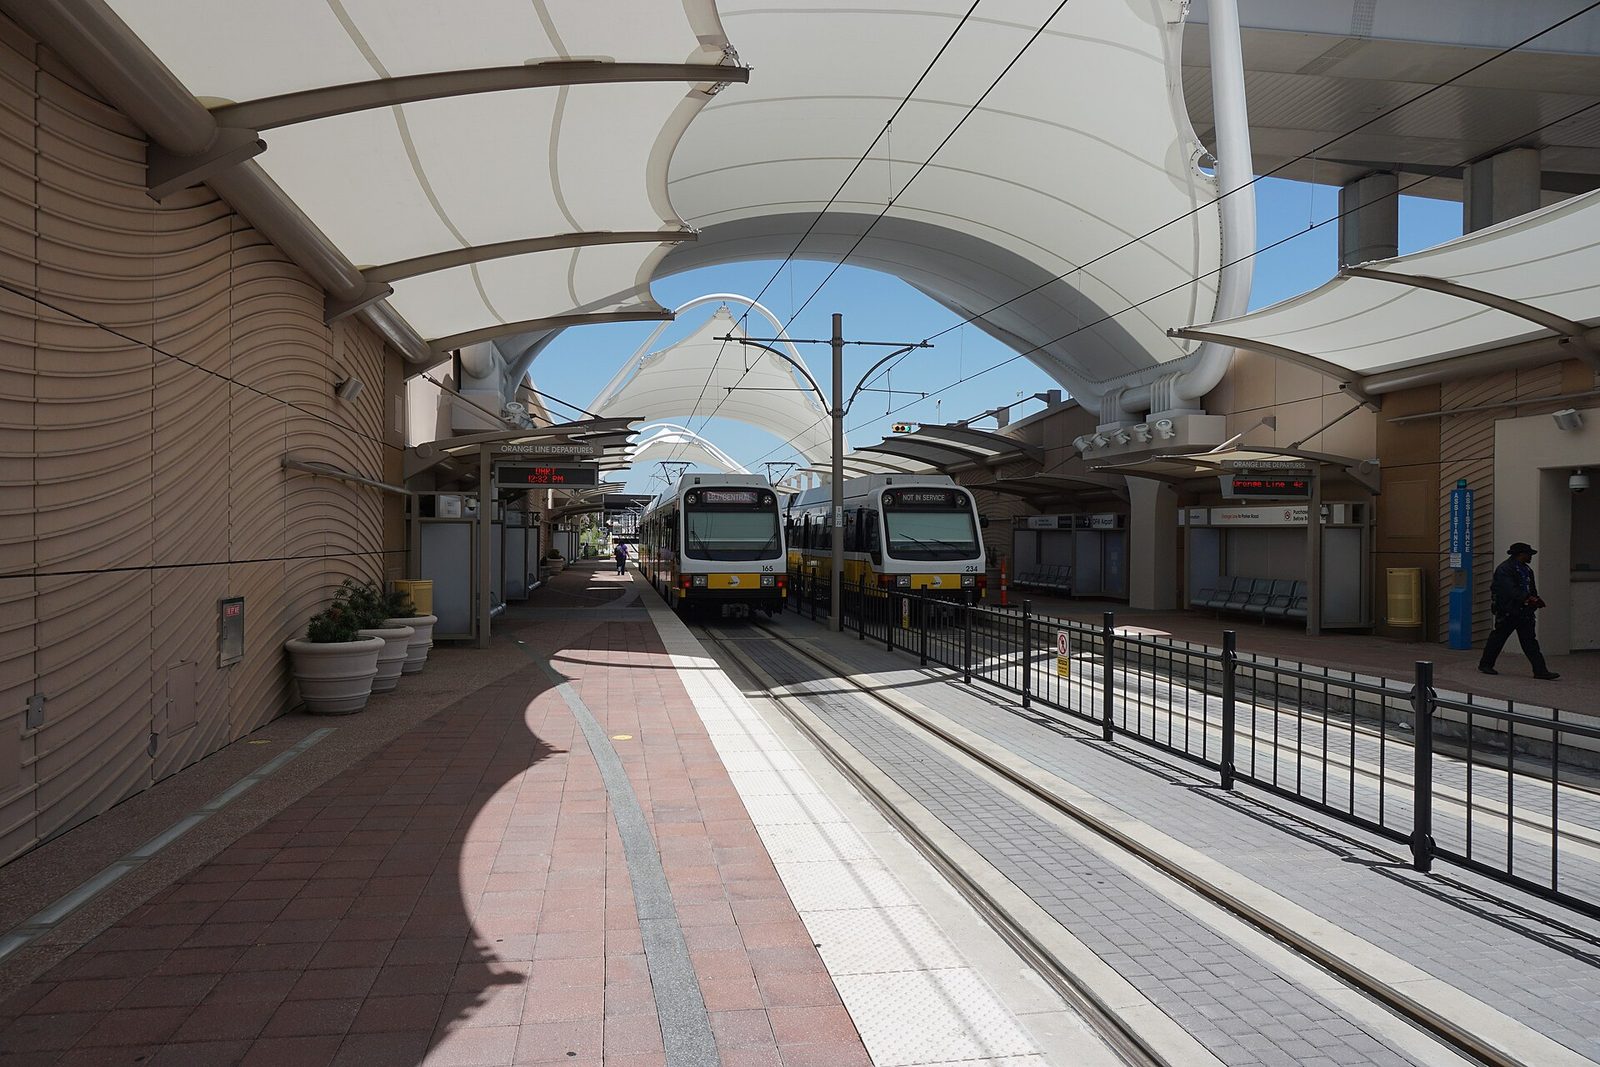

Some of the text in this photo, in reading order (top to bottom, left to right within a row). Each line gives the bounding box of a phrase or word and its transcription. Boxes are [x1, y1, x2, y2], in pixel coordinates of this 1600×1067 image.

[501, 445, 533, 453] ORANGE
[551, 446, 594, 454] DEPARTURES
[552, 475, 564, 483] PM
